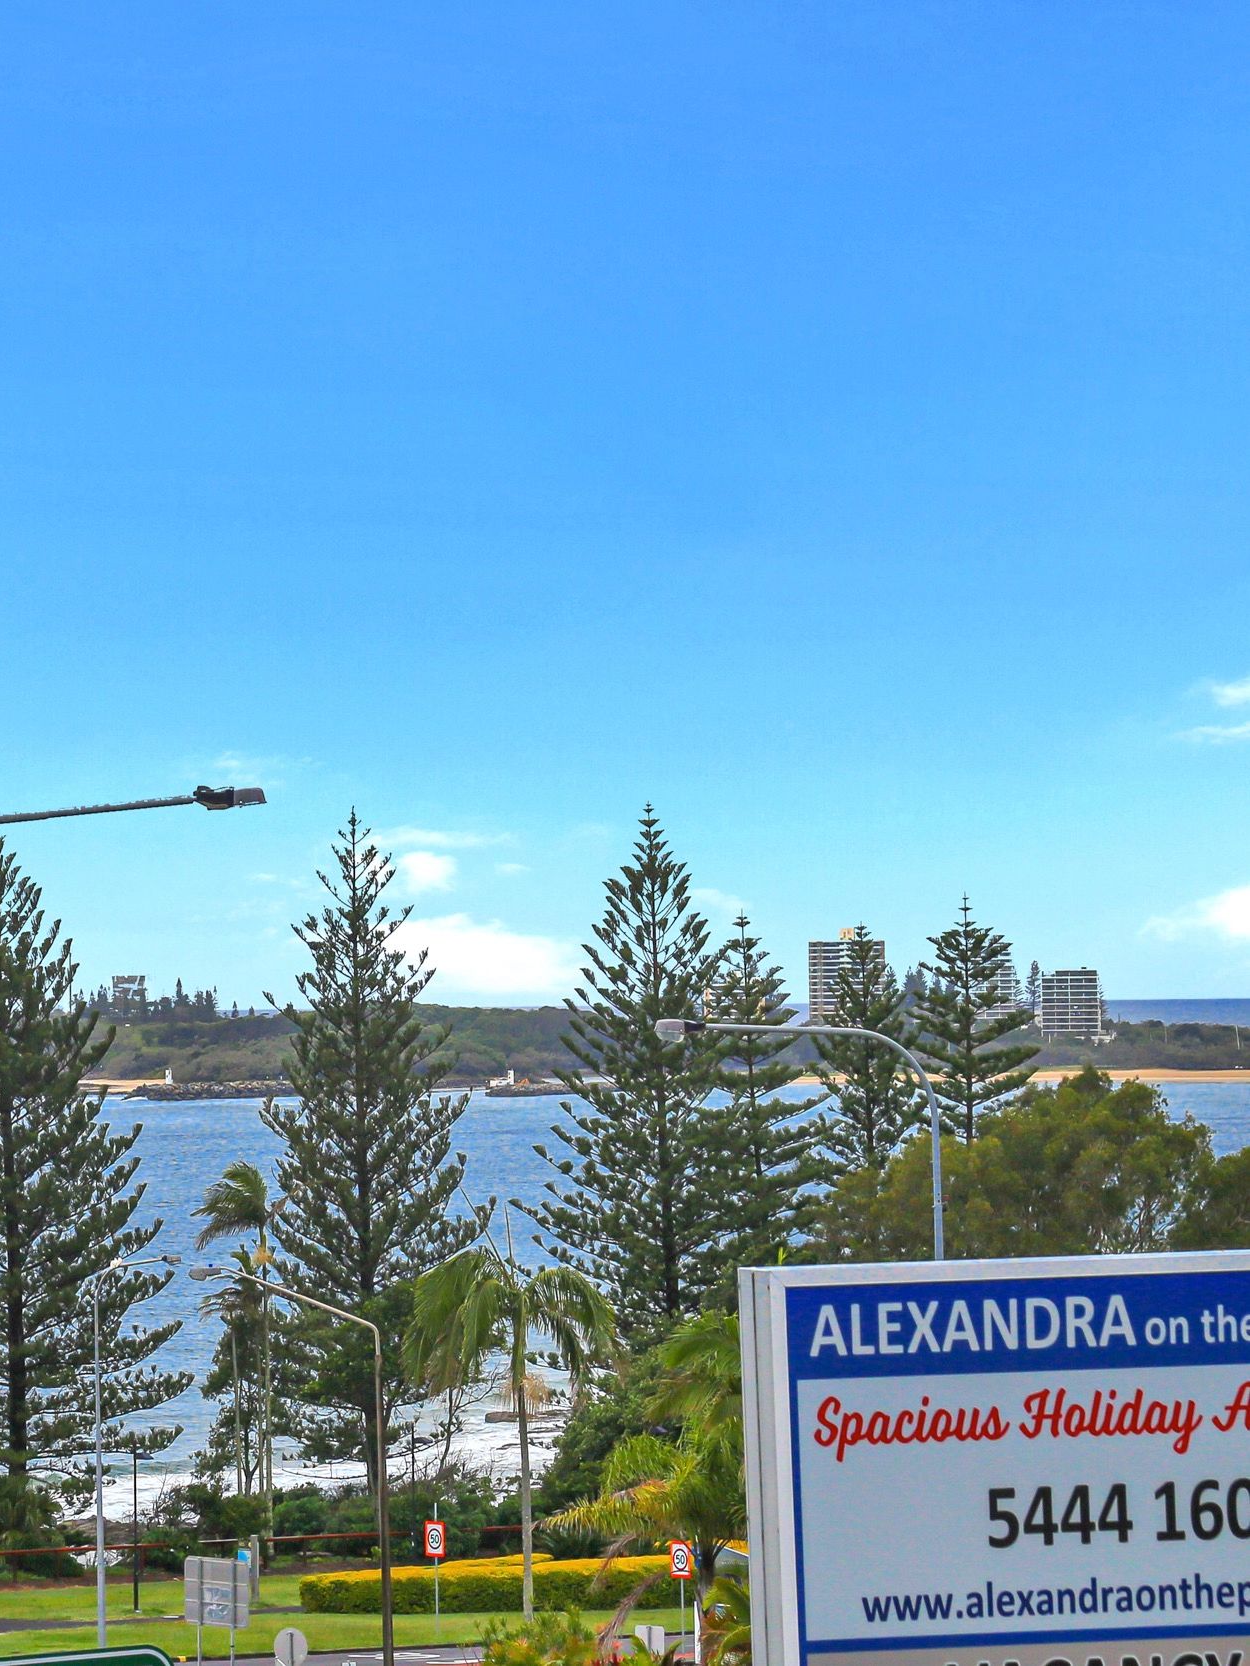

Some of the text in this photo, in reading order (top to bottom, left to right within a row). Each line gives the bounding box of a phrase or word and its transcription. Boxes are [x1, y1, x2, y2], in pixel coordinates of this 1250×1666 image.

[809, 1294, 1136, 1358] ALEXANDRA
[1144, 1316, 1190, 1346] on
[813, 1395, 1011, 1463] Spacious
[1018, 1387, 1203, 1456] Holiday
[430, 1534, 439, 1544] 50
[987, 1478, 1250, 1550] 5444 160
[676, 1555, 685, 1564] 50
[861, 1572, 1250, 1624] www.alexandraonthep
